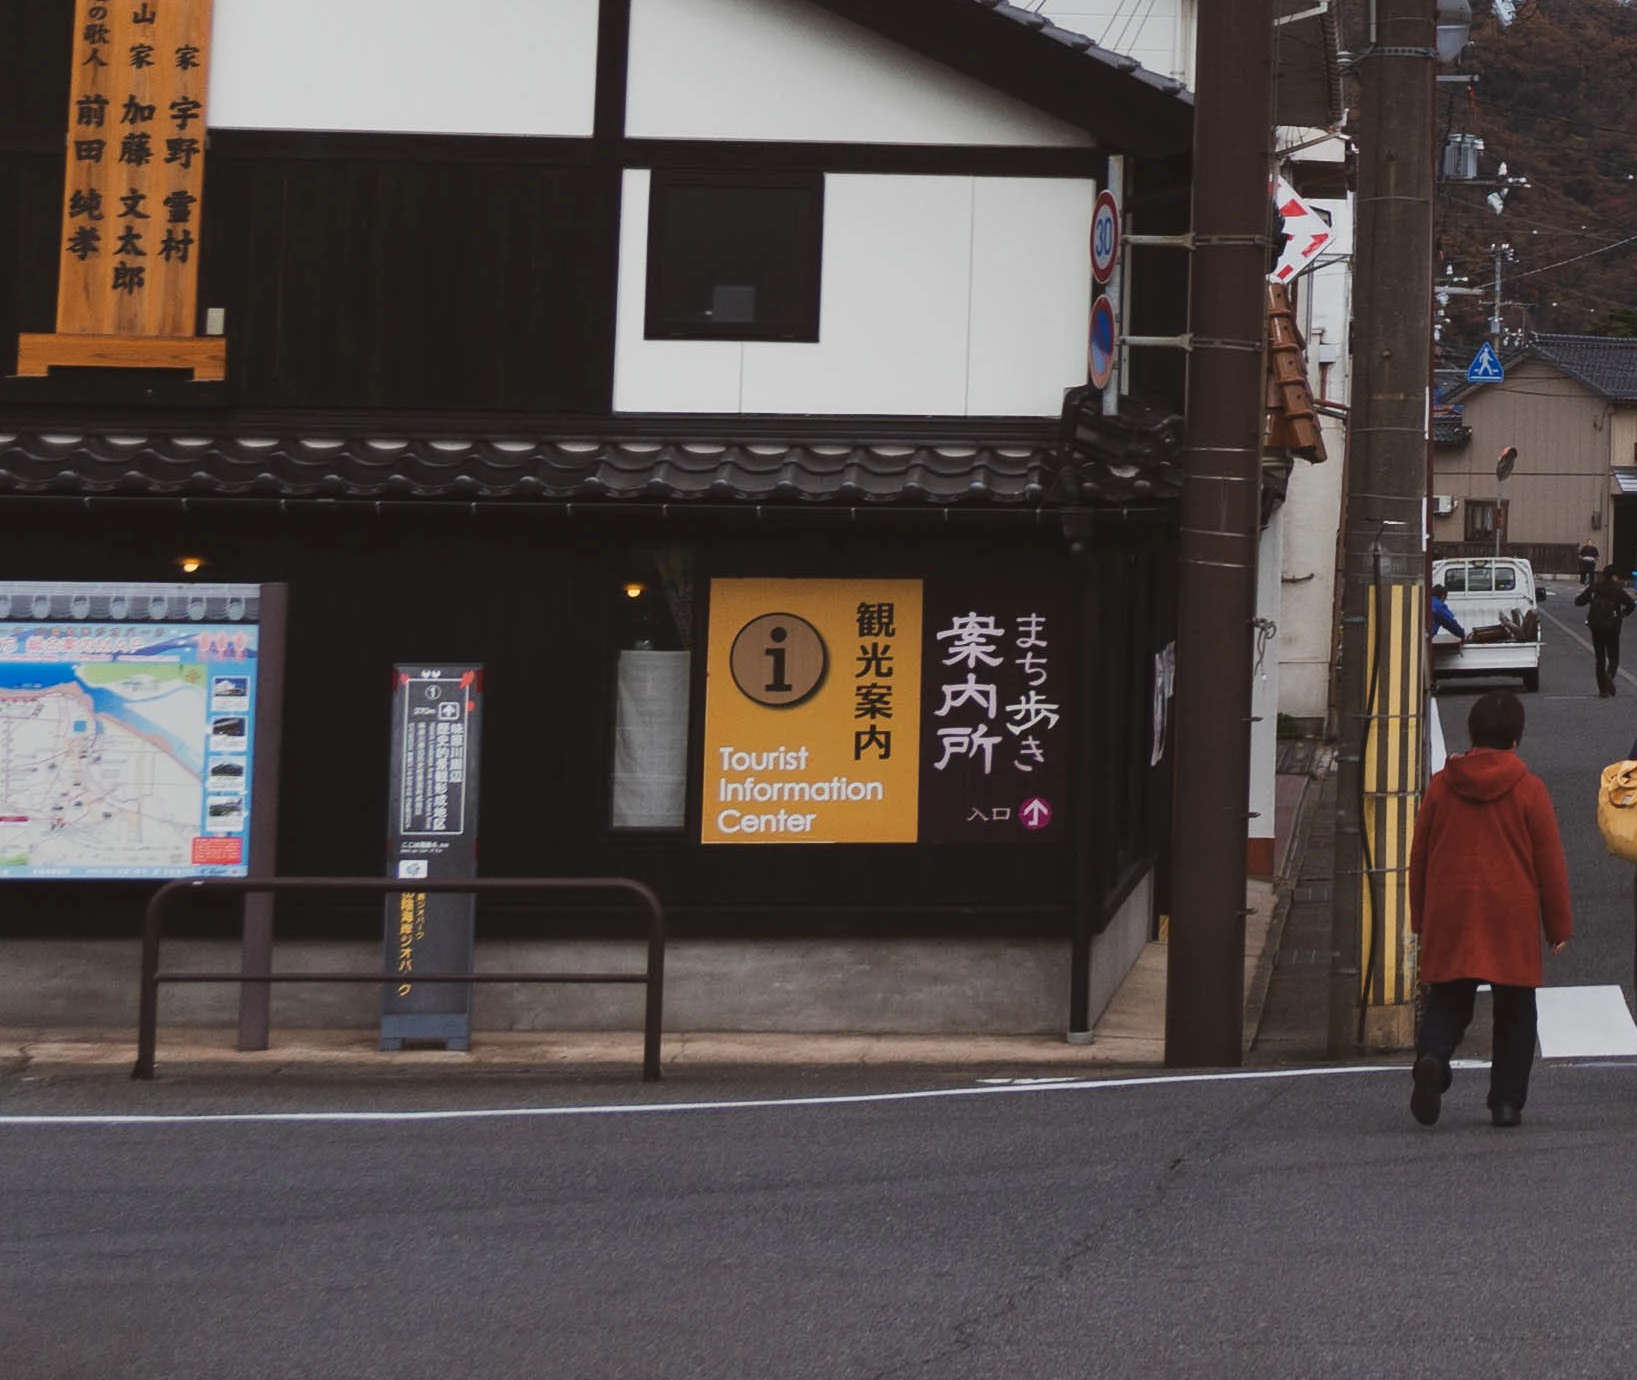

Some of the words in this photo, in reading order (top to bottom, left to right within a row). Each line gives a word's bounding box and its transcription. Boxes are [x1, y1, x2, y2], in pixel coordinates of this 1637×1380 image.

[73, 94, 109, 164] 前田
[118, 94, 155, 167] 加藤
[164, 95, 202, 170] 宇野
[67, 190, 104, 261] 純孝
[111, 188, 150, 295] 文太郎
[158, 190, 198, 263] 雪村
[1096, 217, 1112, 257] 30
[853, 601, 896, 761] 観光案内
[933, 611, 1006, 775] 案内所
[1004, 612, 1060, 773] まち歩き
[718, 777, 883, 802] Information
[719, 746, 809, 771] Tourist
[717, 809, 817, 834] Center
[967, 806, 1011, 822] 入口
